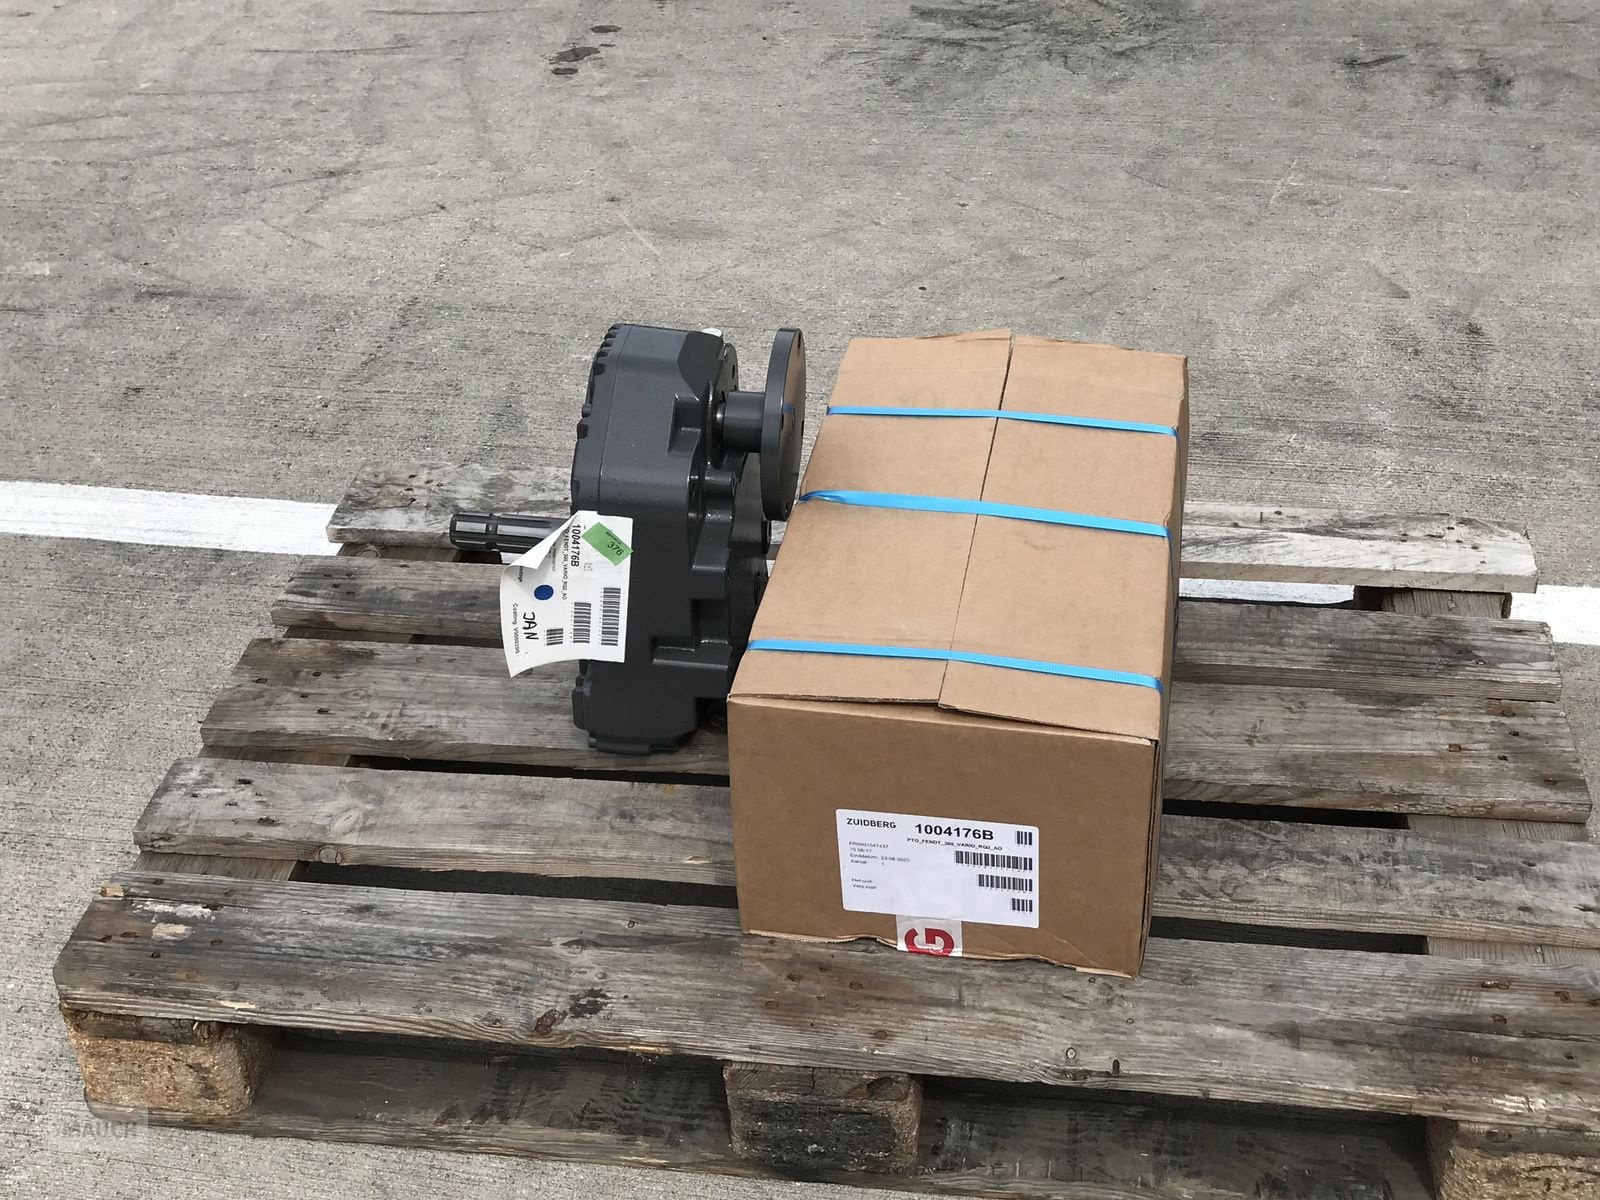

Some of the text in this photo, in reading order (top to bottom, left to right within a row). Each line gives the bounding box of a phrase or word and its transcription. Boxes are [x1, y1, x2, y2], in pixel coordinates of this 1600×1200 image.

[571, 524, 581, 567] 1004176B
[608, 541, 624, 556] 376
[523, 612, 539, 640] JAN
[846, 818, 896, 828] ZUIDBERG
[915, 824, 994, 840] 1004176B
